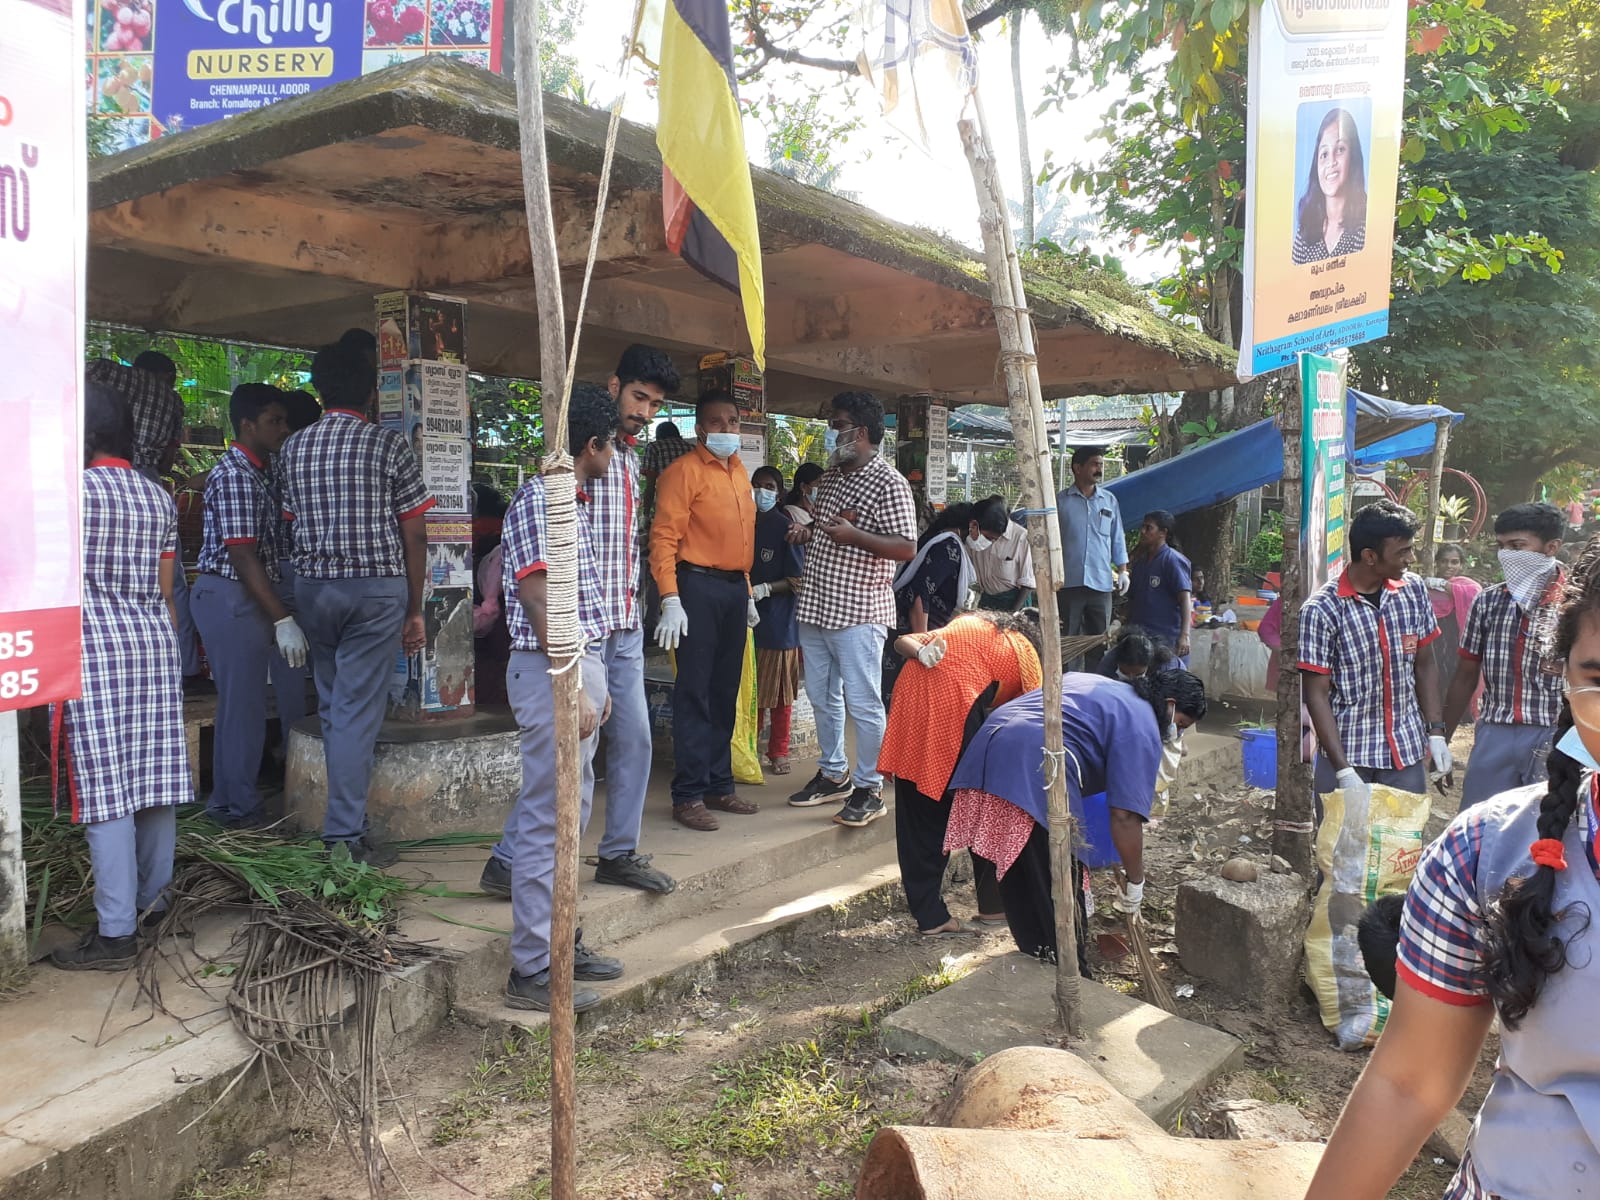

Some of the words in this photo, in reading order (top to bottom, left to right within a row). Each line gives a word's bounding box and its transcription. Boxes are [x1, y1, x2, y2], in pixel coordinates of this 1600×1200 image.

[196, 52, 326, 74] NURSERY
[209, 84, 278, 96] CHENNAMPALLI,
[279, 83, 311, 95] ADOOR
[190, 98, 220, 109] Branch:
[1294, 332, 1315, 347] School
[1315, 330, 1323, 341] of
[0, 630, 34, 660] 85
